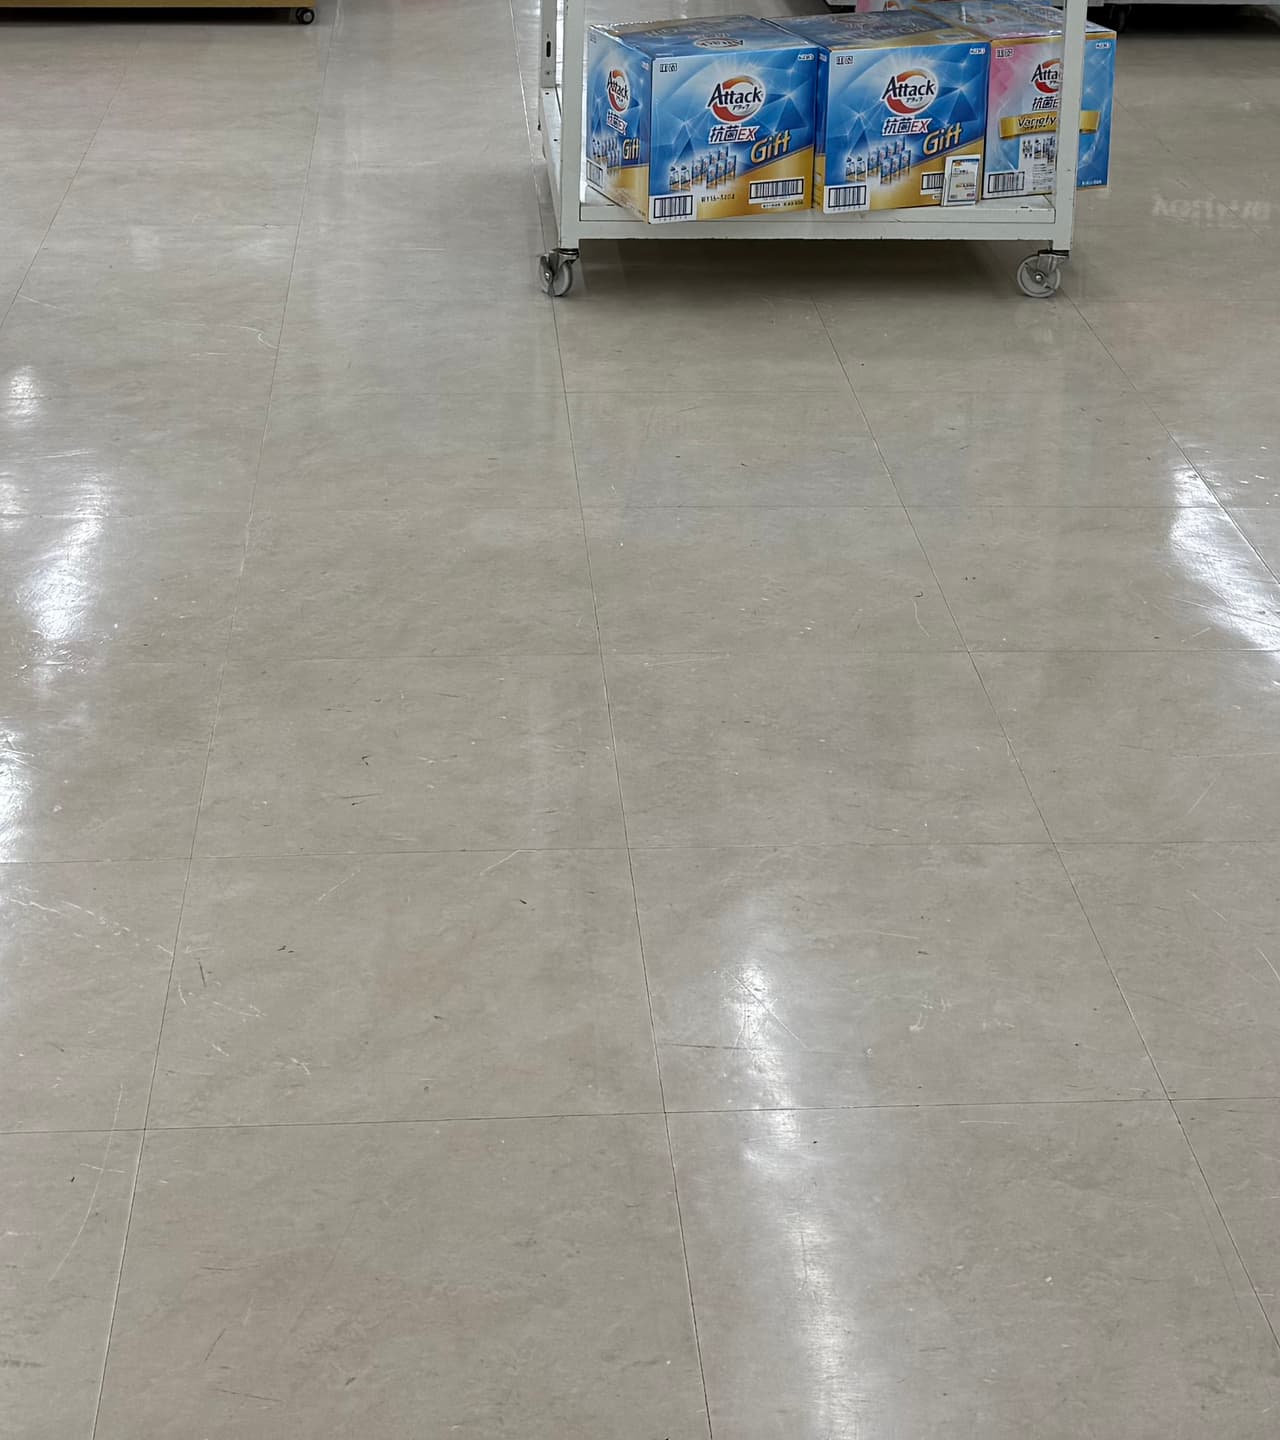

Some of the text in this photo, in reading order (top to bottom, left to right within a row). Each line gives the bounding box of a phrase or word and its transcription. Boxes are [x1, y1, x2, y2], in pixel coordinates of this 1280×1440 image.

[707, 83, 762, 107] Attack
[882, 76, 935, 99] Attack
[710, 127, 757, 143] 抗菌EX
[882, 116, 930, 135] 抗菌EX
[751, 130, 791, 164] Gift
[923, 122, 963, 155] Gift
